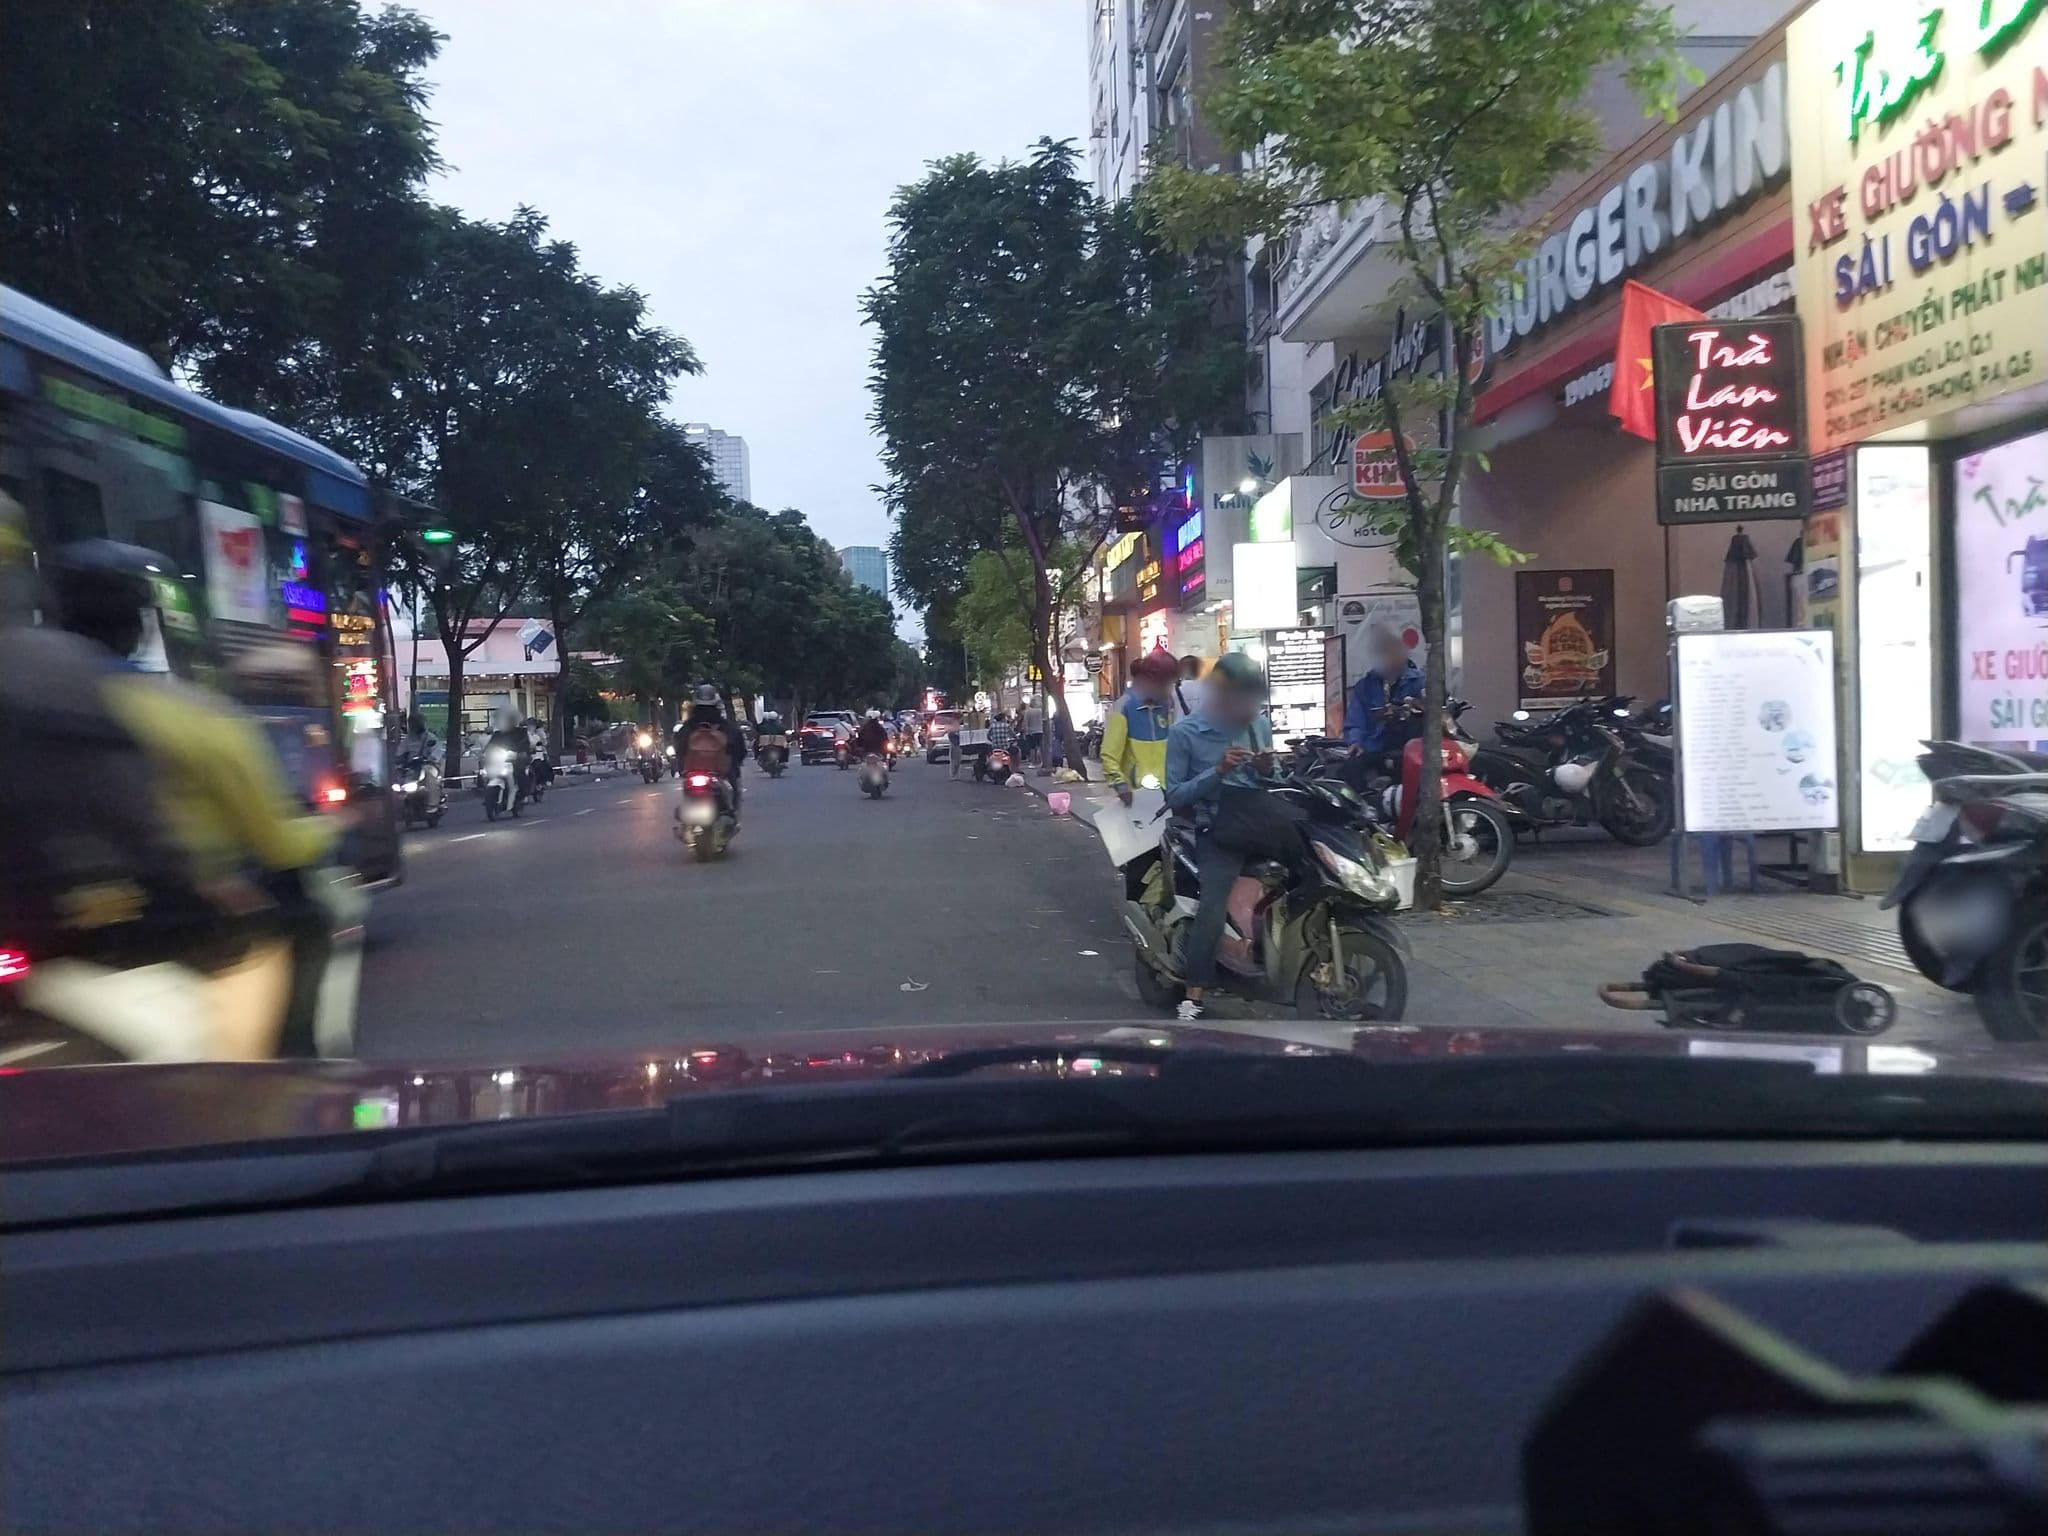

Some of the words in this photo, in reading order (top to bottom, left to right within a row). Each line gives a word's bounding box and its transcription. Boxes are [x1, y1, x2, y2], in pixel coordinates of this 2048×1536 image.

[1809, 185, 1847, 252] XE
[1861, 88, 2011, 218] GIƯỜNG
[1489, 162, 1661, 354] BURGER
[1671, 63, 1786, 237] KIN
[1836, 231, 1891, 304] SÀI
[1908, 182, 1991, 273] GÒN
[1951, 268, 2006, 320] PHÁT
[1688, 331, 1771, 370] Trà
[1686, 373, 1778, 410] Lan
[1677, 415, 1790, 453] Viên
[1692, 472, 1726, 492] SÀI
[1731, 470, 1778, 490] GÒN
[1675, 496, 1720, 513] NHA
[1724, 492, 1797, 510] TRANG
[1972, 649, 1997, 680] XE
[1991, 689, 2024, 730] SÀI
